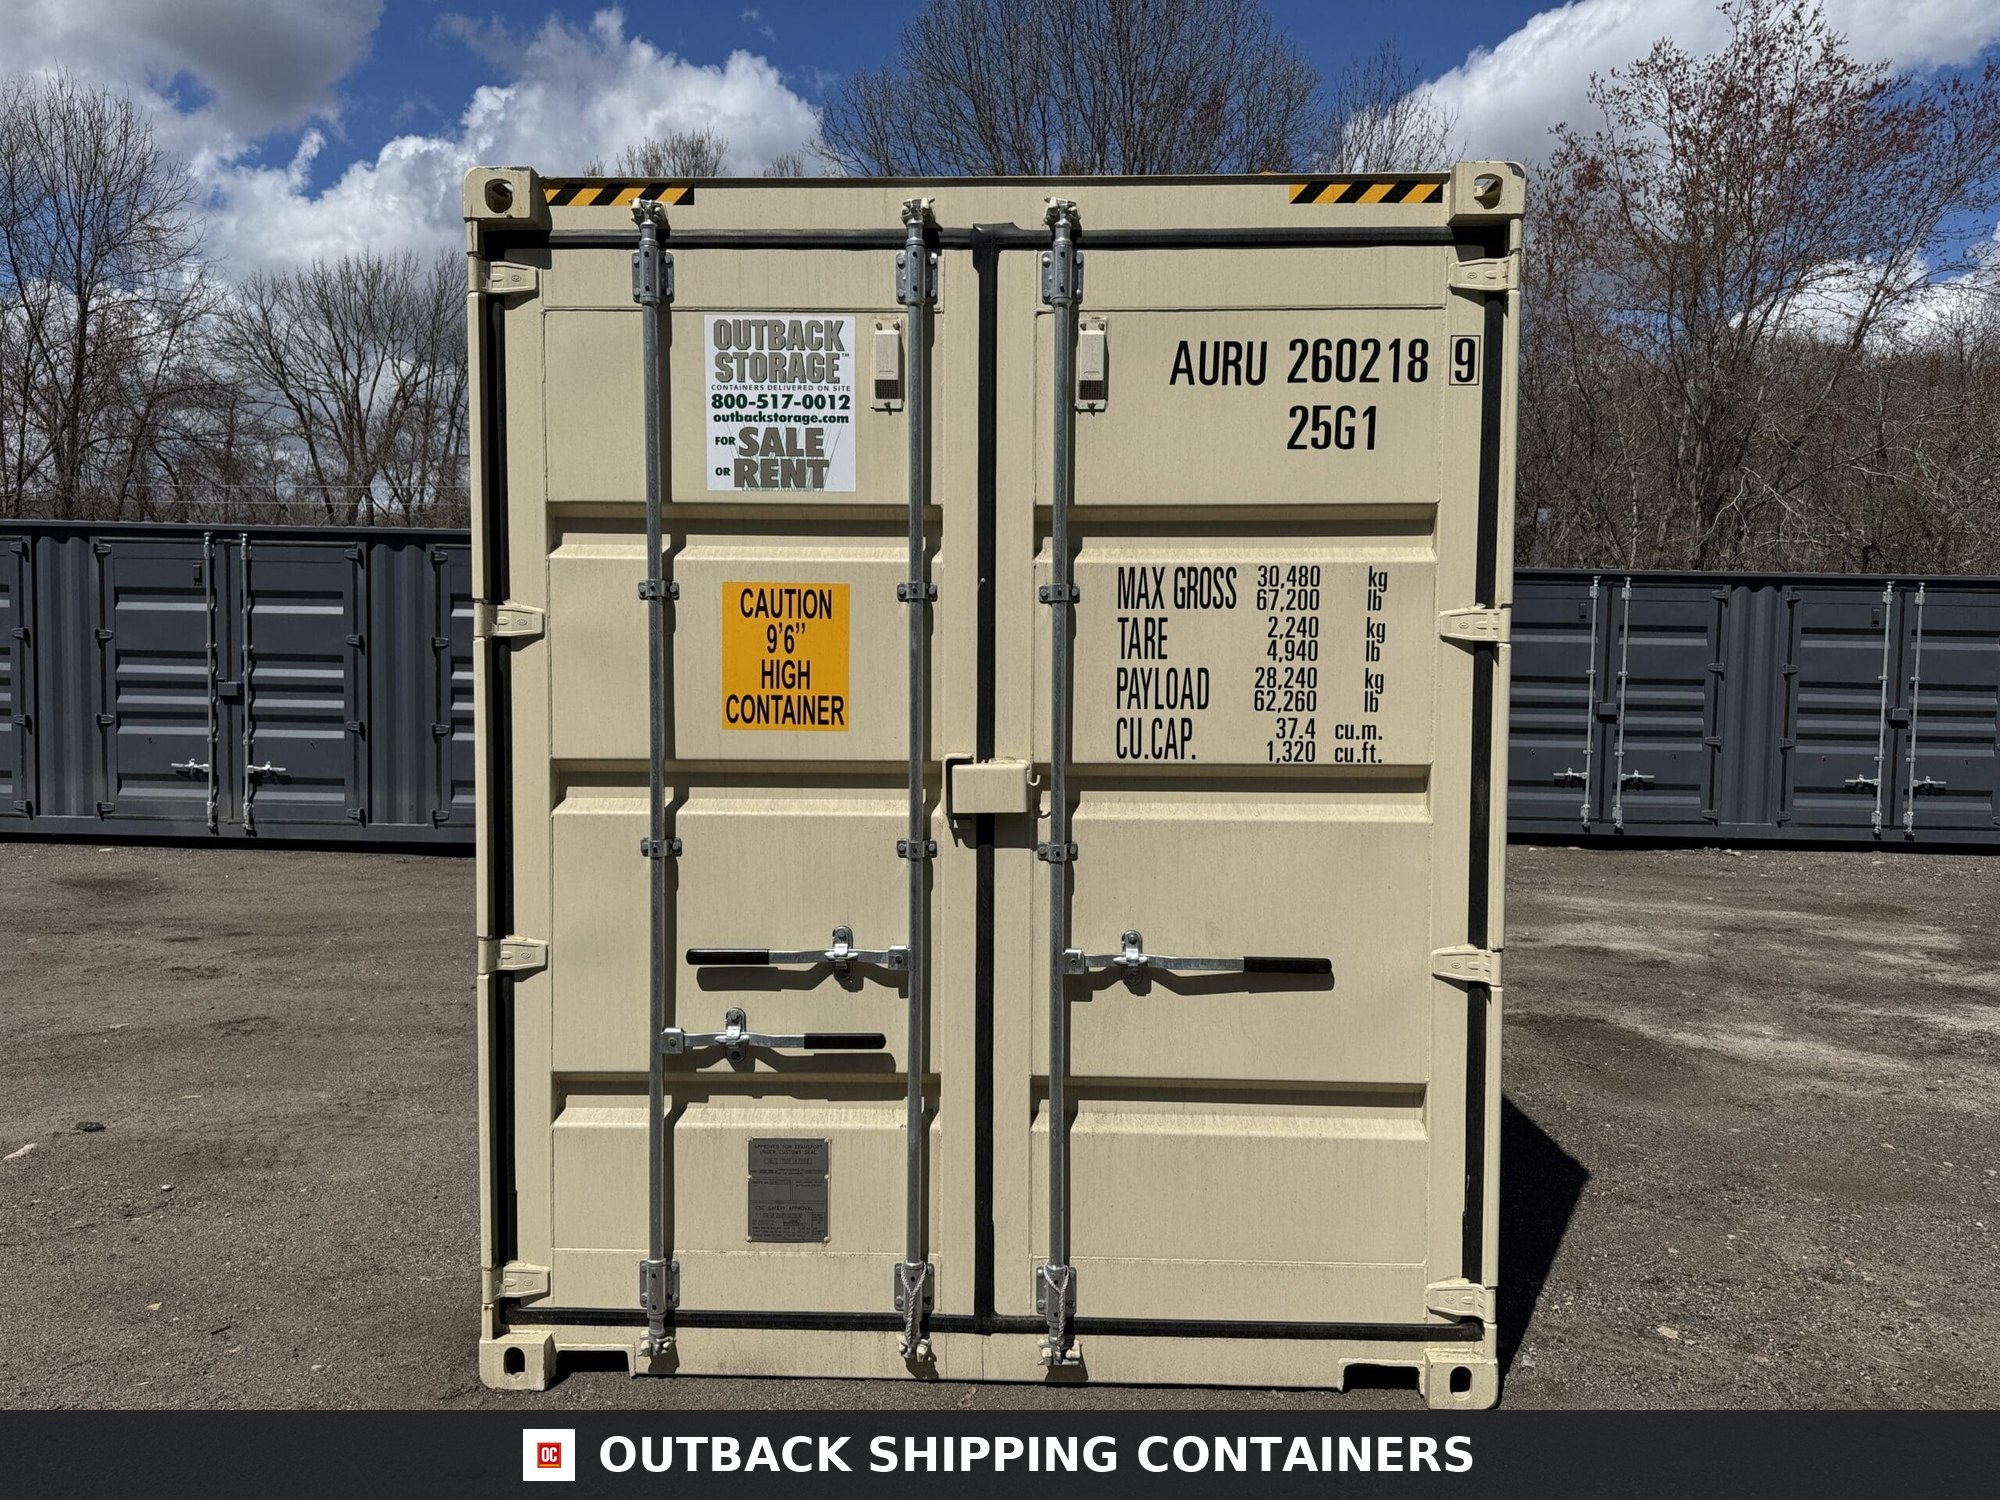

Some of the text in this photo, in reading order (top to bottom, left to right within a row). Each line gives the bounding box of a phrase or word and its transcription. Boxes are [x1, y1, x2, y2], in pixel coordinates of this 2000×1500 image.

[713, 319, 845, 351] OUTBACK
[714, 352, 841, 384] STORAGE
[1169, 338, 1476, 386] AURU 260218 9
[711, 393, 850, 410] 800-517-0012
[713, 411, 849, 425] outbackstorage.com
[1287, 405, 1377, 450] 25G1
[715, 426, 825, 457] FOR SALE
[715, 458, 830, 489] OR RENT
[1117, 565, 1388, 610] MAX GROSS 30,480 kg
[1256, 589, 1382, 612] 67,200 lb
[740, 588, 832, 619] CAUTION
[1117, 617, 1386, 660] TARE 2,240 kg
[1266, 640, 1380, 663] 4,940 lb
[761, 659, 811, 690] HIGH
[1116, 667, 1384, 710] PAYLOAD 28,240 kg
[726, 694, 845, 726] CONTAINER
[1254, 691, 1379, 713] 62,260 lb
[1116, 717, 1383, 760] CU.CAP. 37.4 cu.m.
[1266, 741, 1383, 764] 1,320 cu.ft.
